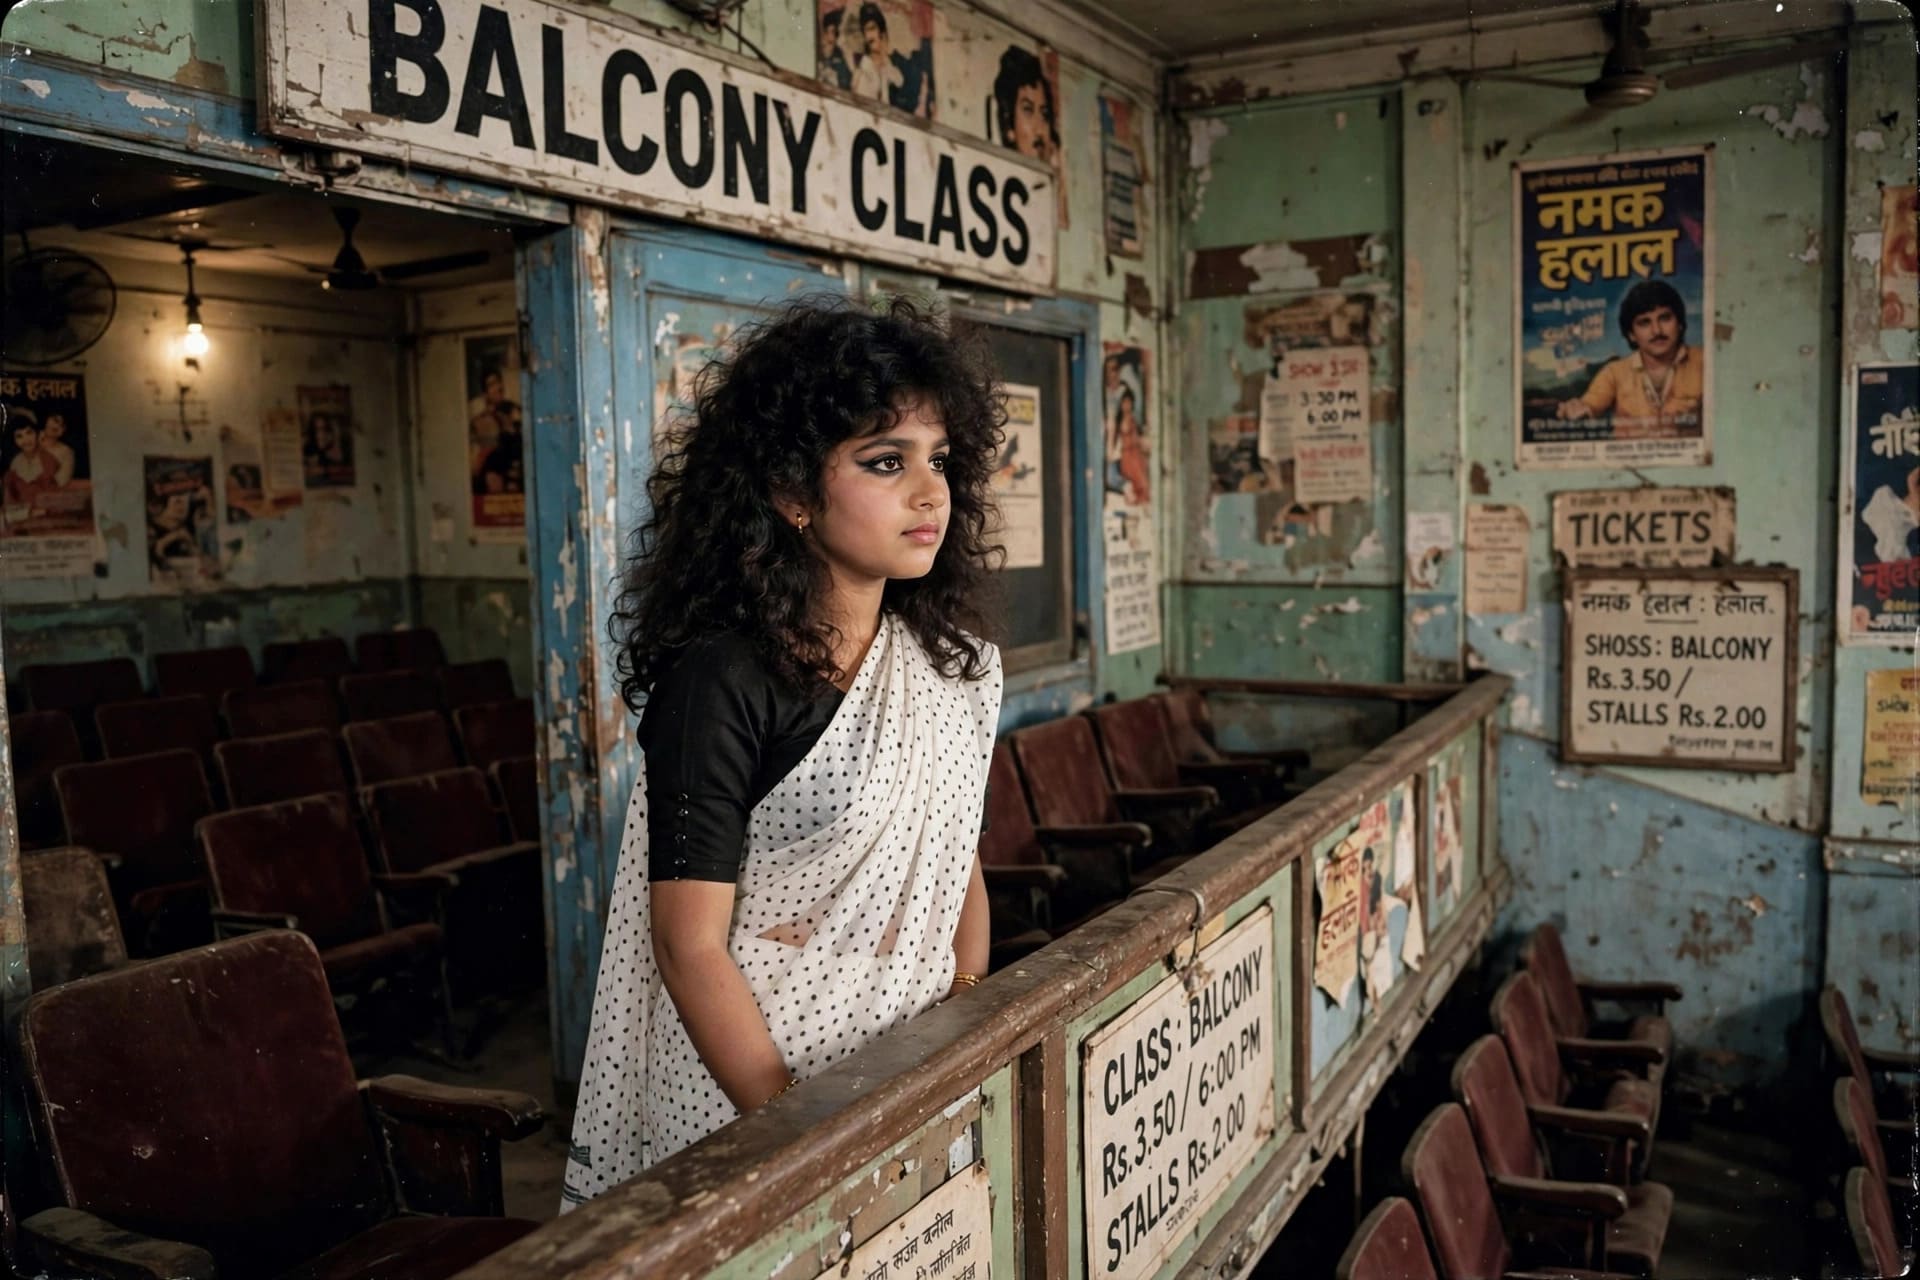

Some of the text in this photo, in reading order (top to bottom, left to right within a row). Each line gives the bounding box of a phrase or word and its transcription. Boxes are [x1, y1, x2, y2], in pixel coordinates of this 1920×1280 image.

[369, 0, 820, 215] BALCONY
[850, 127, 1031, 266] CLASS
[1537, 182, 1666, 235] नमक
[1536, 229, 1680, 289] हलाल
[1568, 510, 1712, 547] TICKETS
[1671, 635, 1773, 661] BALCONY
[1587, 701, 1767, 730] STALLS Rs.2.00
[1189, 945, 1263, 1048] BALCONY
[1199, 1041, 1236, 1107] 6:00
[1241, 1016, 1261, 1070] PM
[1106, 1092, 1245, 1272] STALLS Rs.2.00
